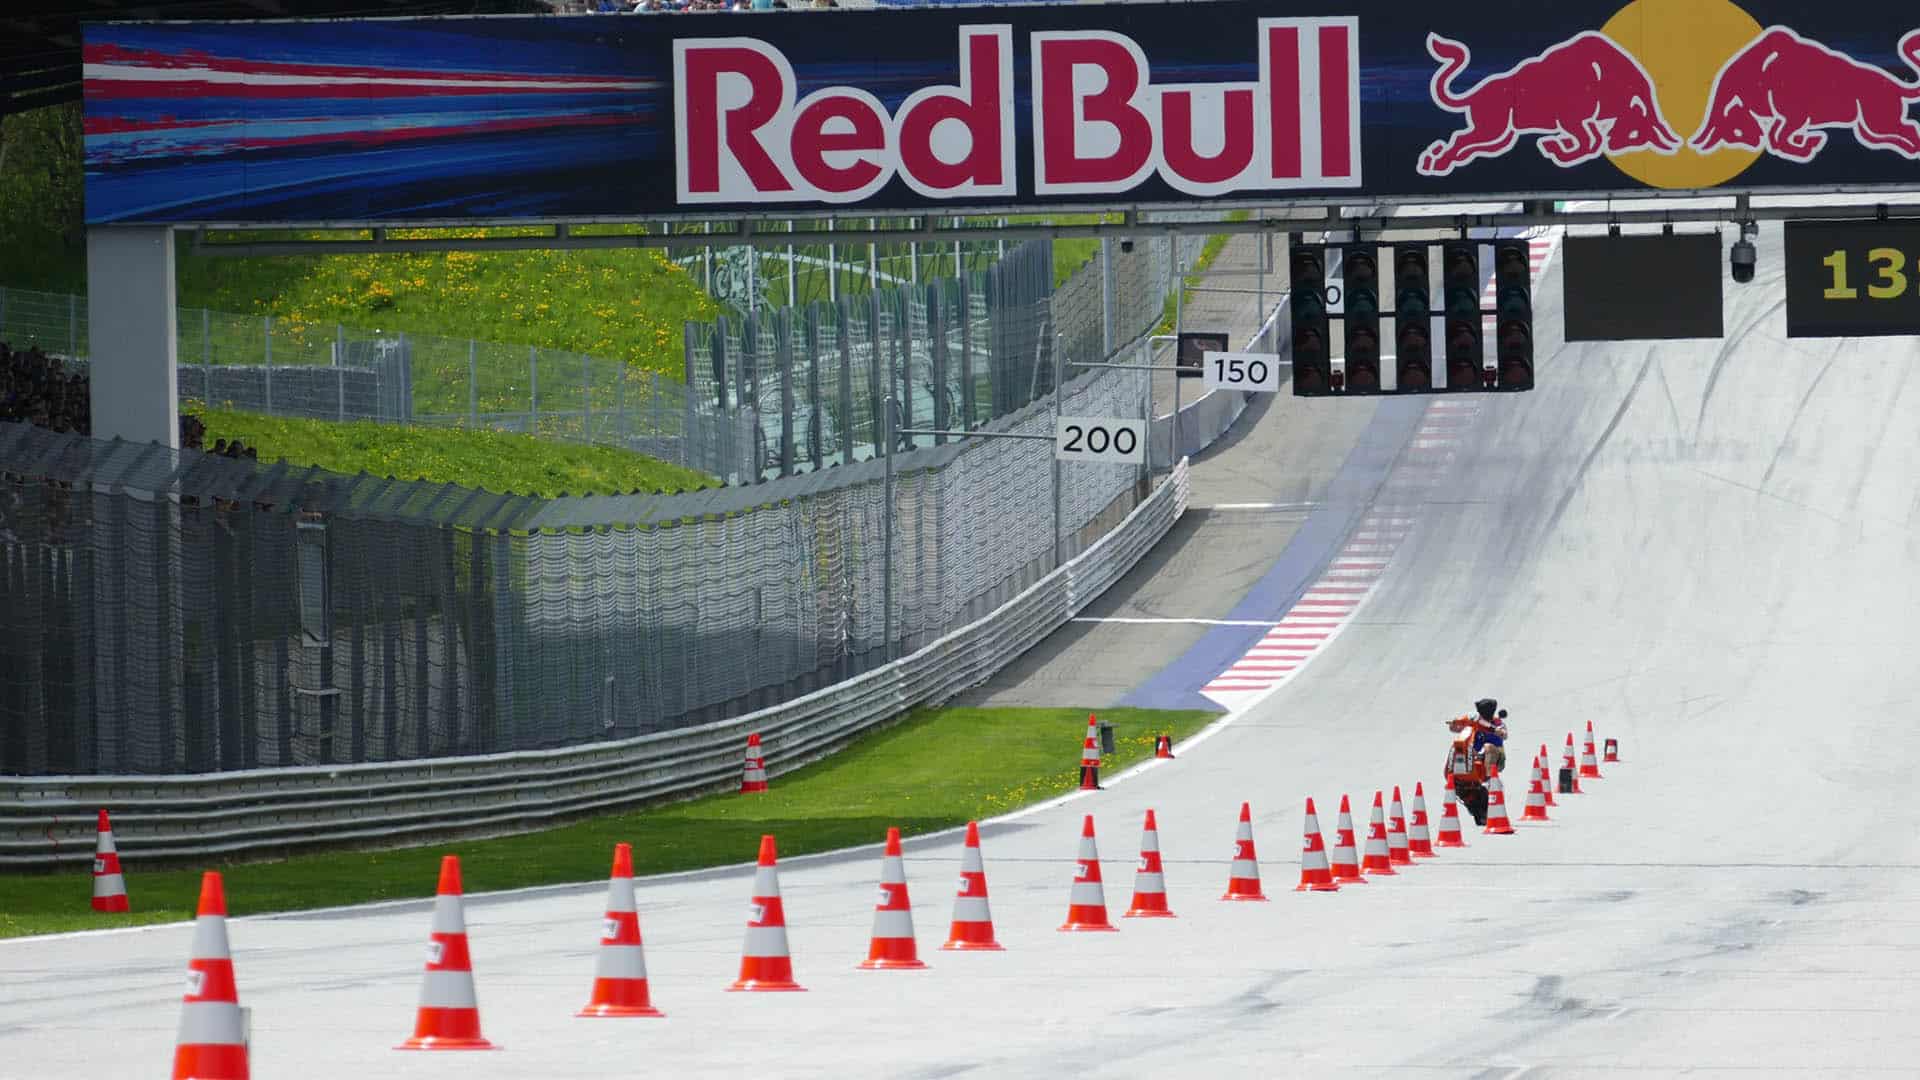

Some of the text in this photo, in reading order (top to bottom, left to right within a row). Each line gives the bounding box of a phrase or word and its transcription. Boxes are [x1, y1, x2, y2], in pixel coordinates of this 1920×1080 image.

[682, 25, 1353, 194] Red Bull
[1823, 247, 1920, 299] 13
[1214, 359, 1268, 385] 150
[1063, 425, 1137, 455] 200
